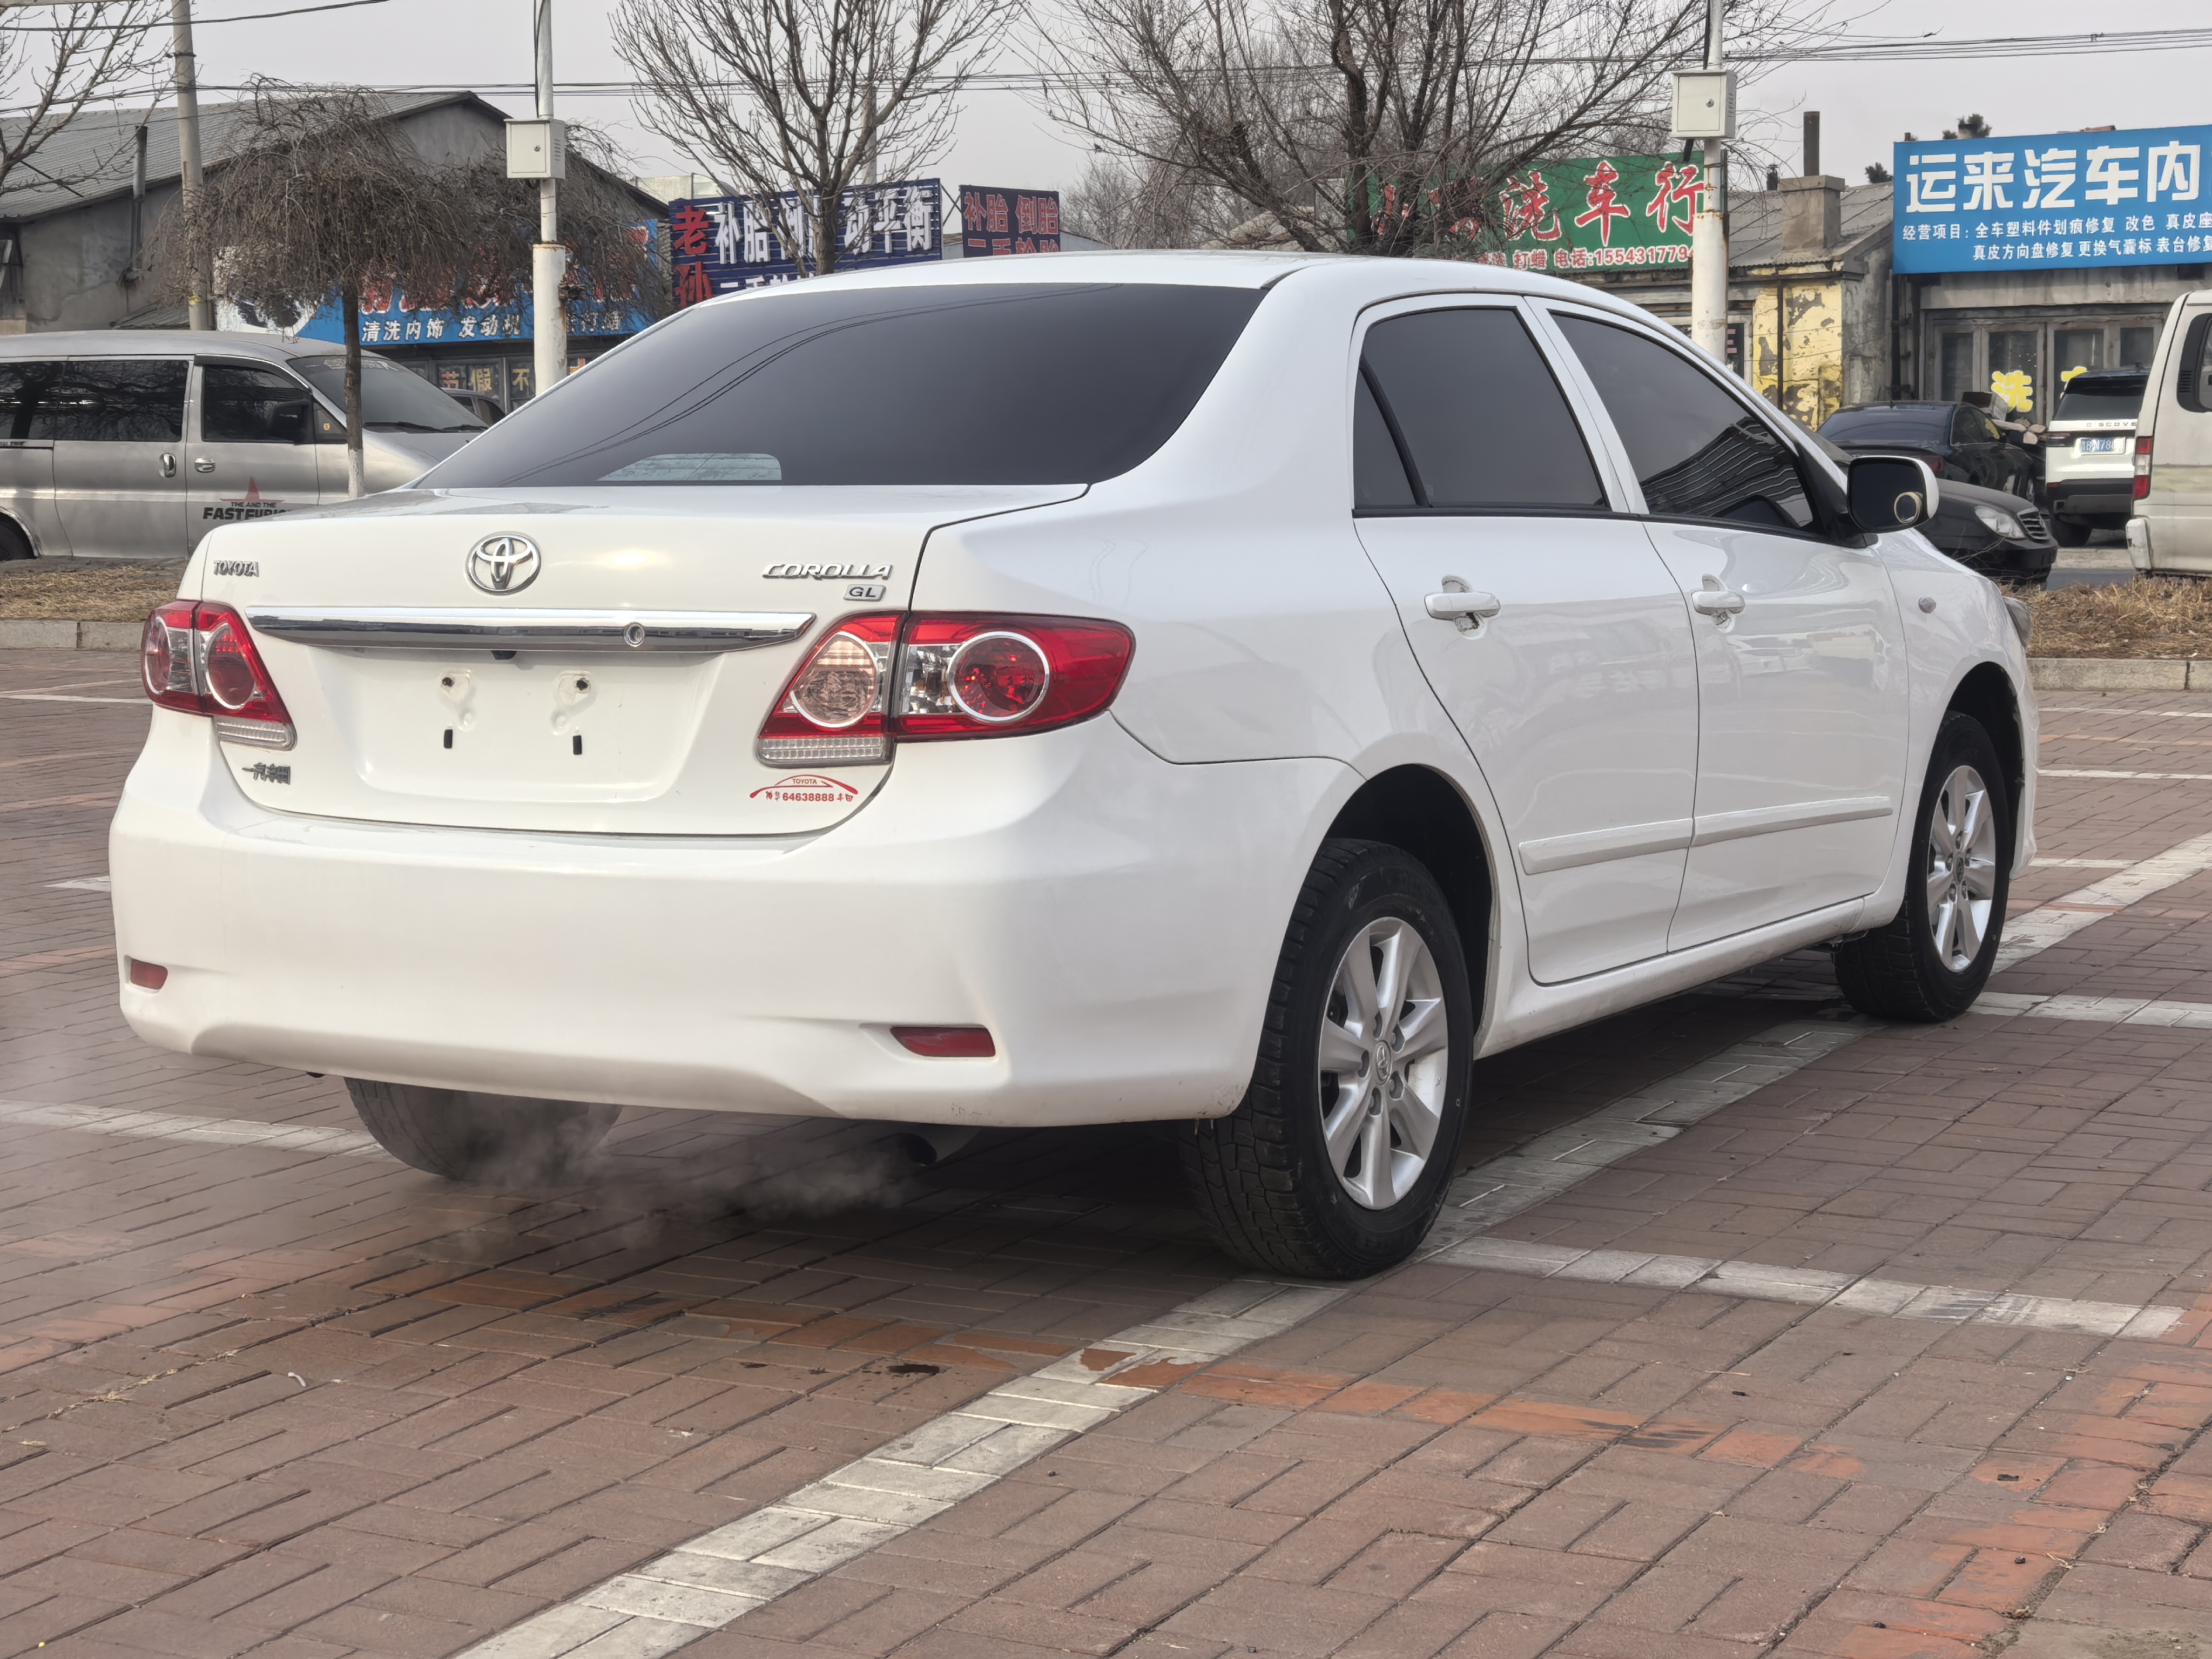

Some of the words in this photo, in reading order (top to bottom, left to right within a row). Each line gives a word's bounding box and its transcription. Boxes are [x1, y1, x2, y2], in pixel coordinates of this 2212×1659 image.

[964, 192, 1008, 232] 补胎
[1015, 195, 1058, 234] 倒胎
[2126, 214, 2155, 231] 改色
[673, 205, 713, 309] 老孙
[362, 318, 444, 342] 清洗内饰
[1991, 370, 2033, 413] 洗
[213, 560, 259, 577] TOYOTA
[762, 563, 893, 581] COROLLA
[849, 586, 876, 598] GL
[783, 792, 835, 802] 64638888
